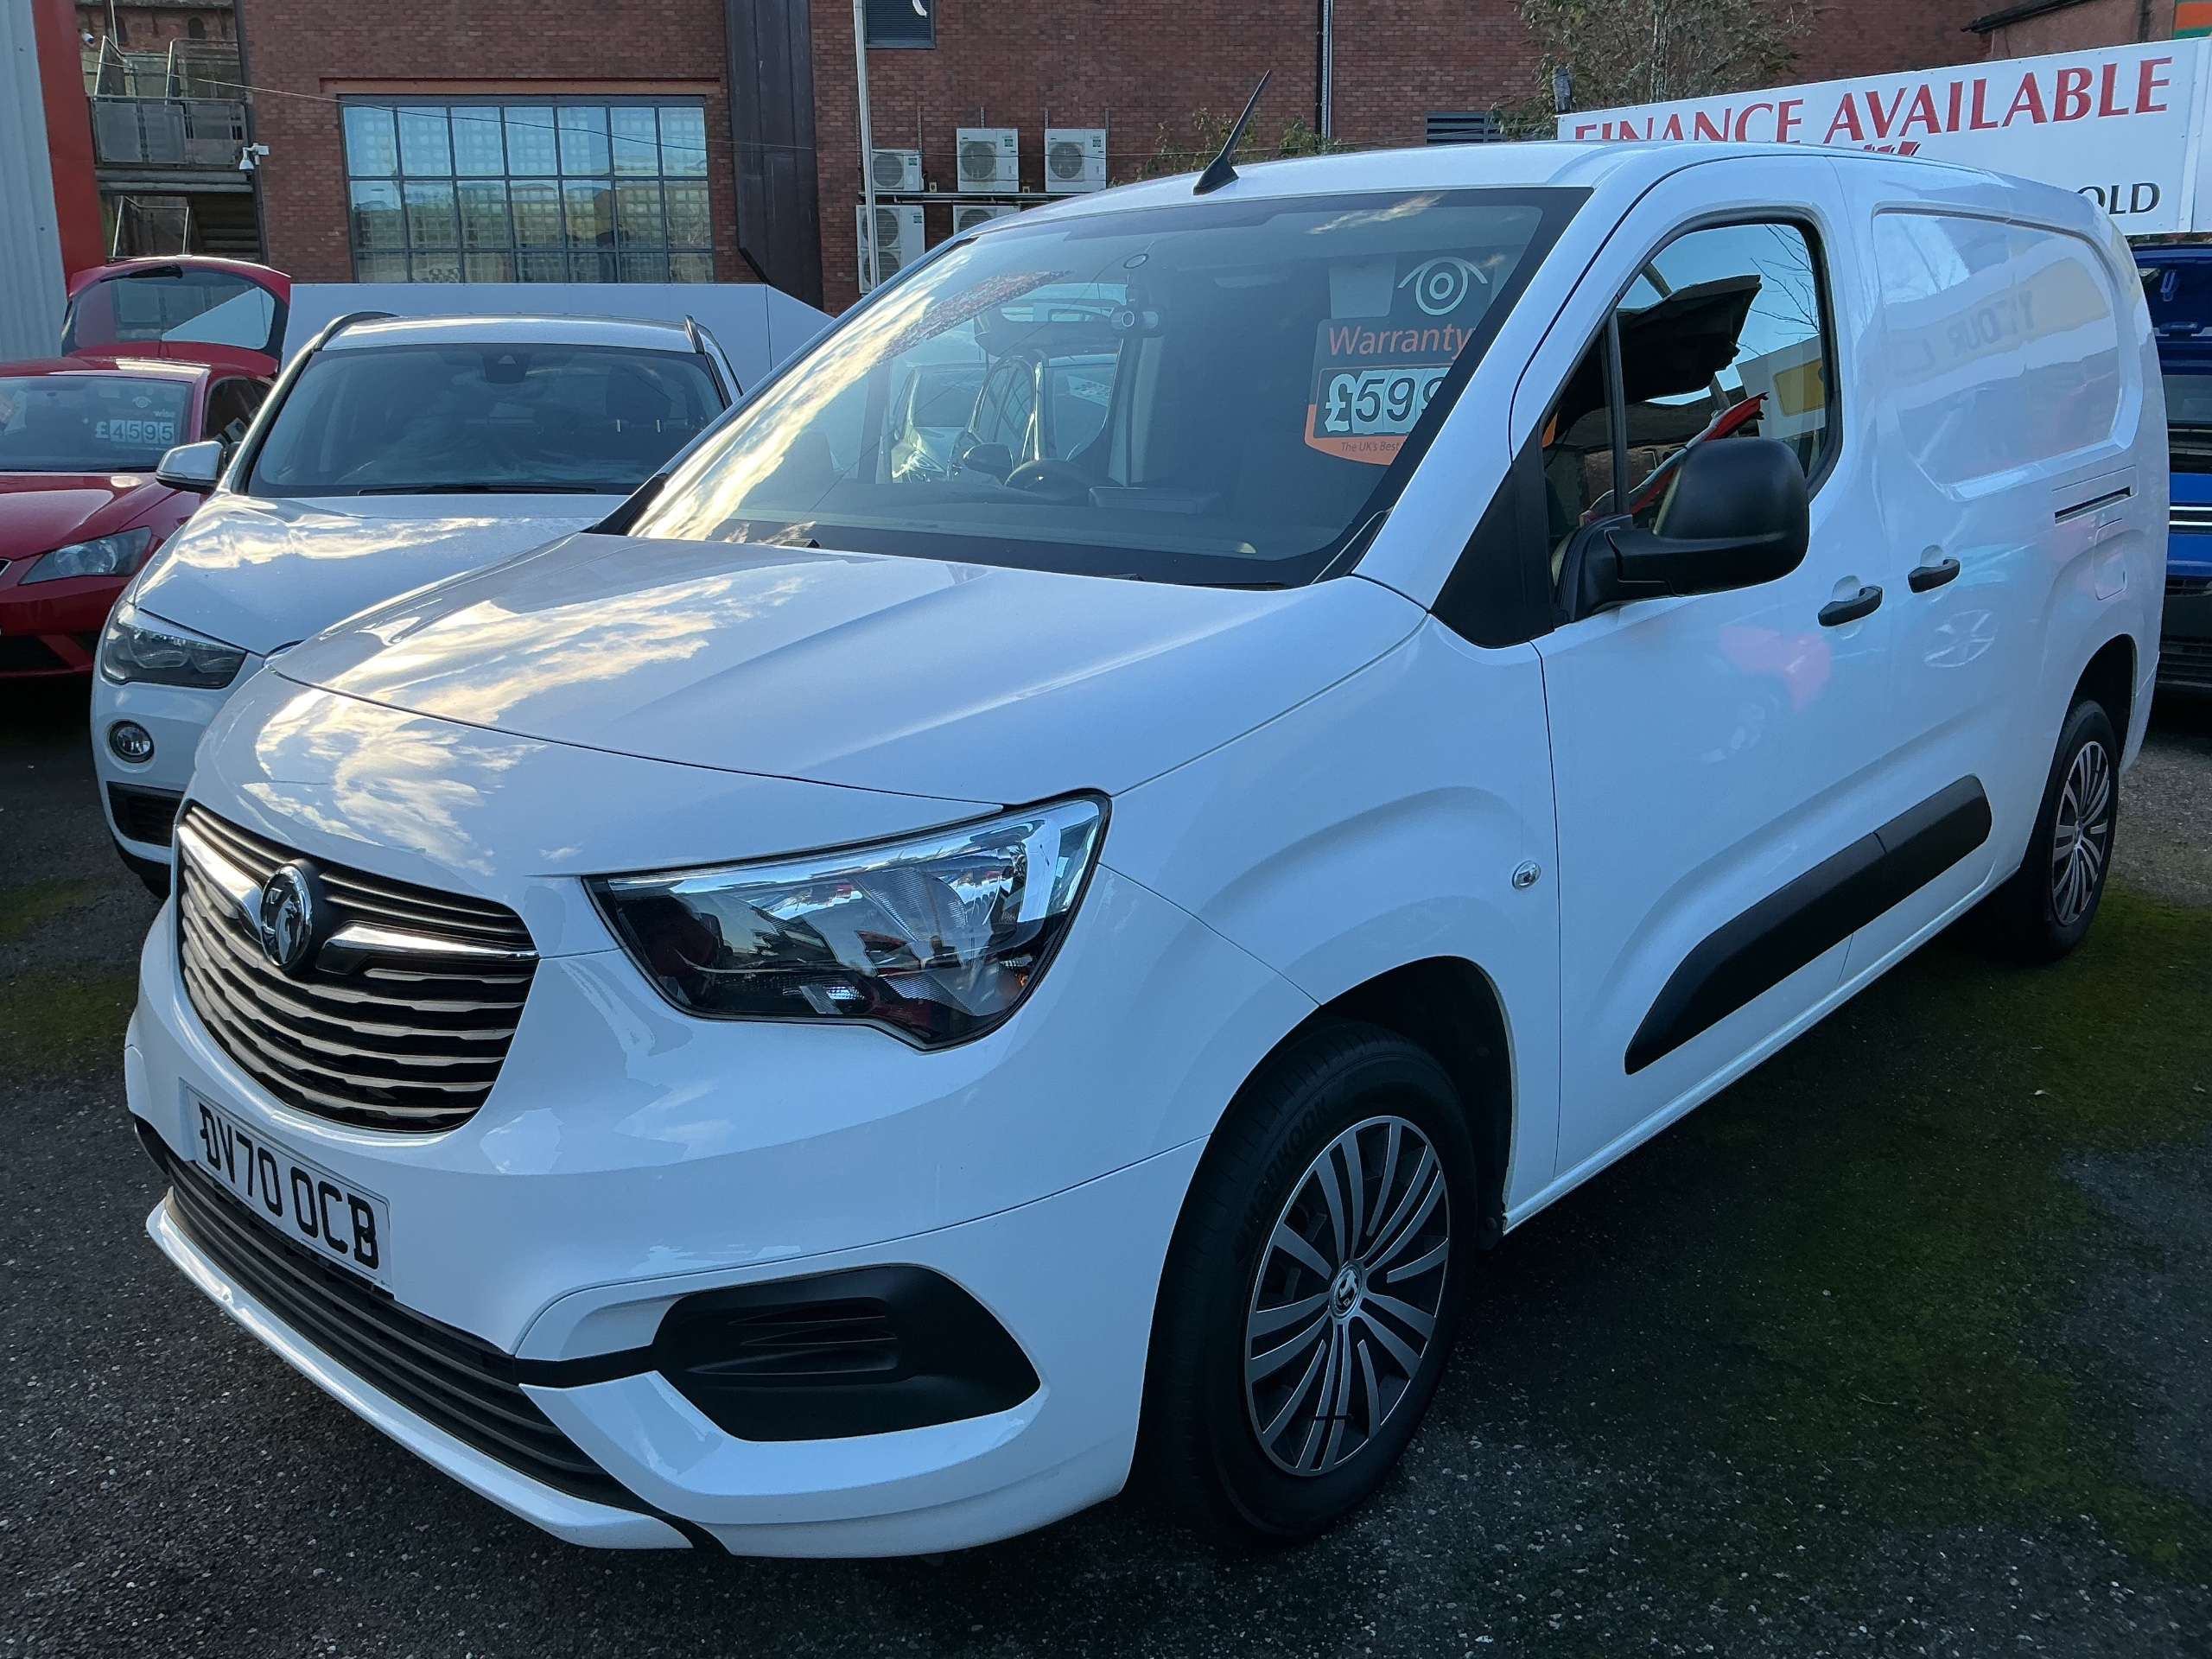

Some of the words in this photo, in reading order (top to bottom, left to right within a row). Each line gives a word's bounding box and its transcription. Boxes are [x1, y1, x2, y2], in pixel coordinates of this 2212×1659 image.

[1823, 56, 2173, 143] AVAILABLE
[1328, 323, 1476, 359] Warranty
[96, 421, 174, 442] £4595
[1341, 442, 1357, 452] The
[199, 1102, 283, 1217] DV70
[290, 1166, 379, 1270] OCB
